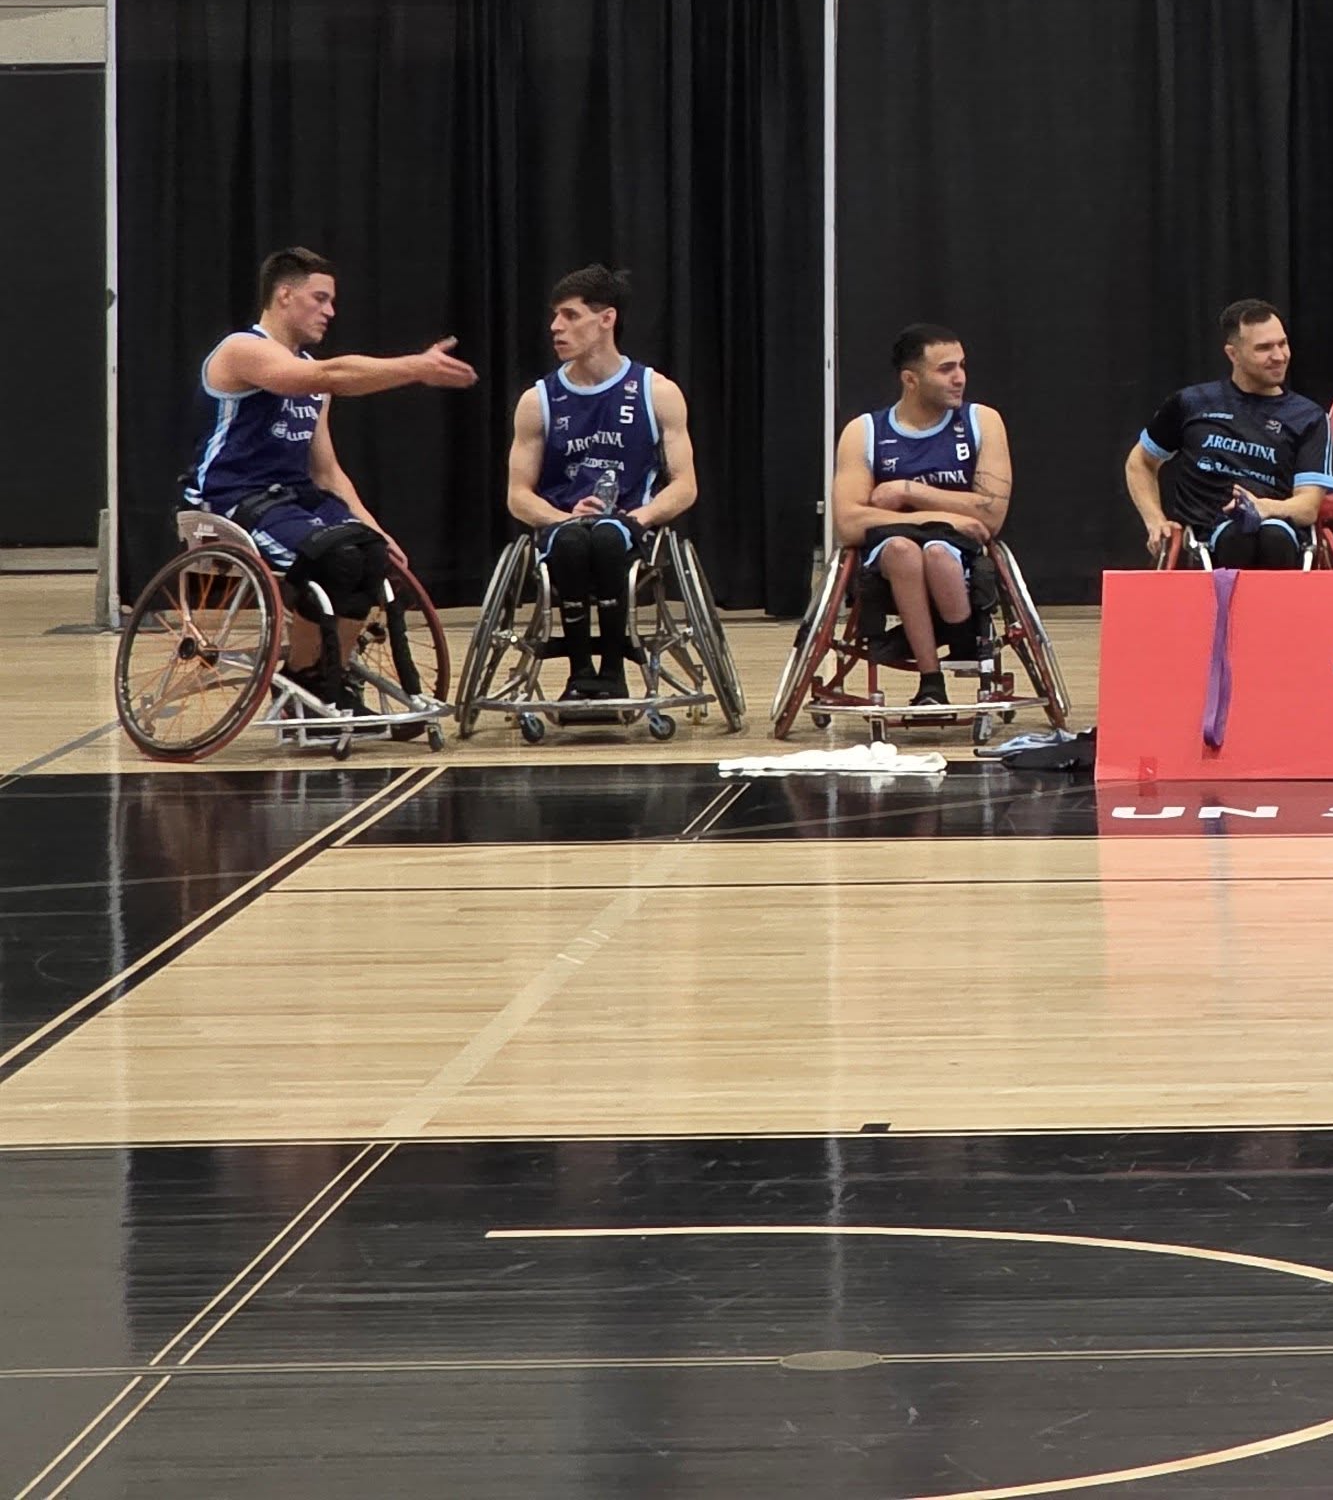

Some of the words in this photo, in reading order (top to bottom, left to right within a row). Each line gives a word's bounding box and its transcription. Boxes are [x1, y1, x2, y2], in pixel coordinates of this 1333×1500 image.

[618, 404, 635, 424] 5
[1202, 434, 1277, 464] ARGENTINA
[1111, 805, 1279, 819] UN
